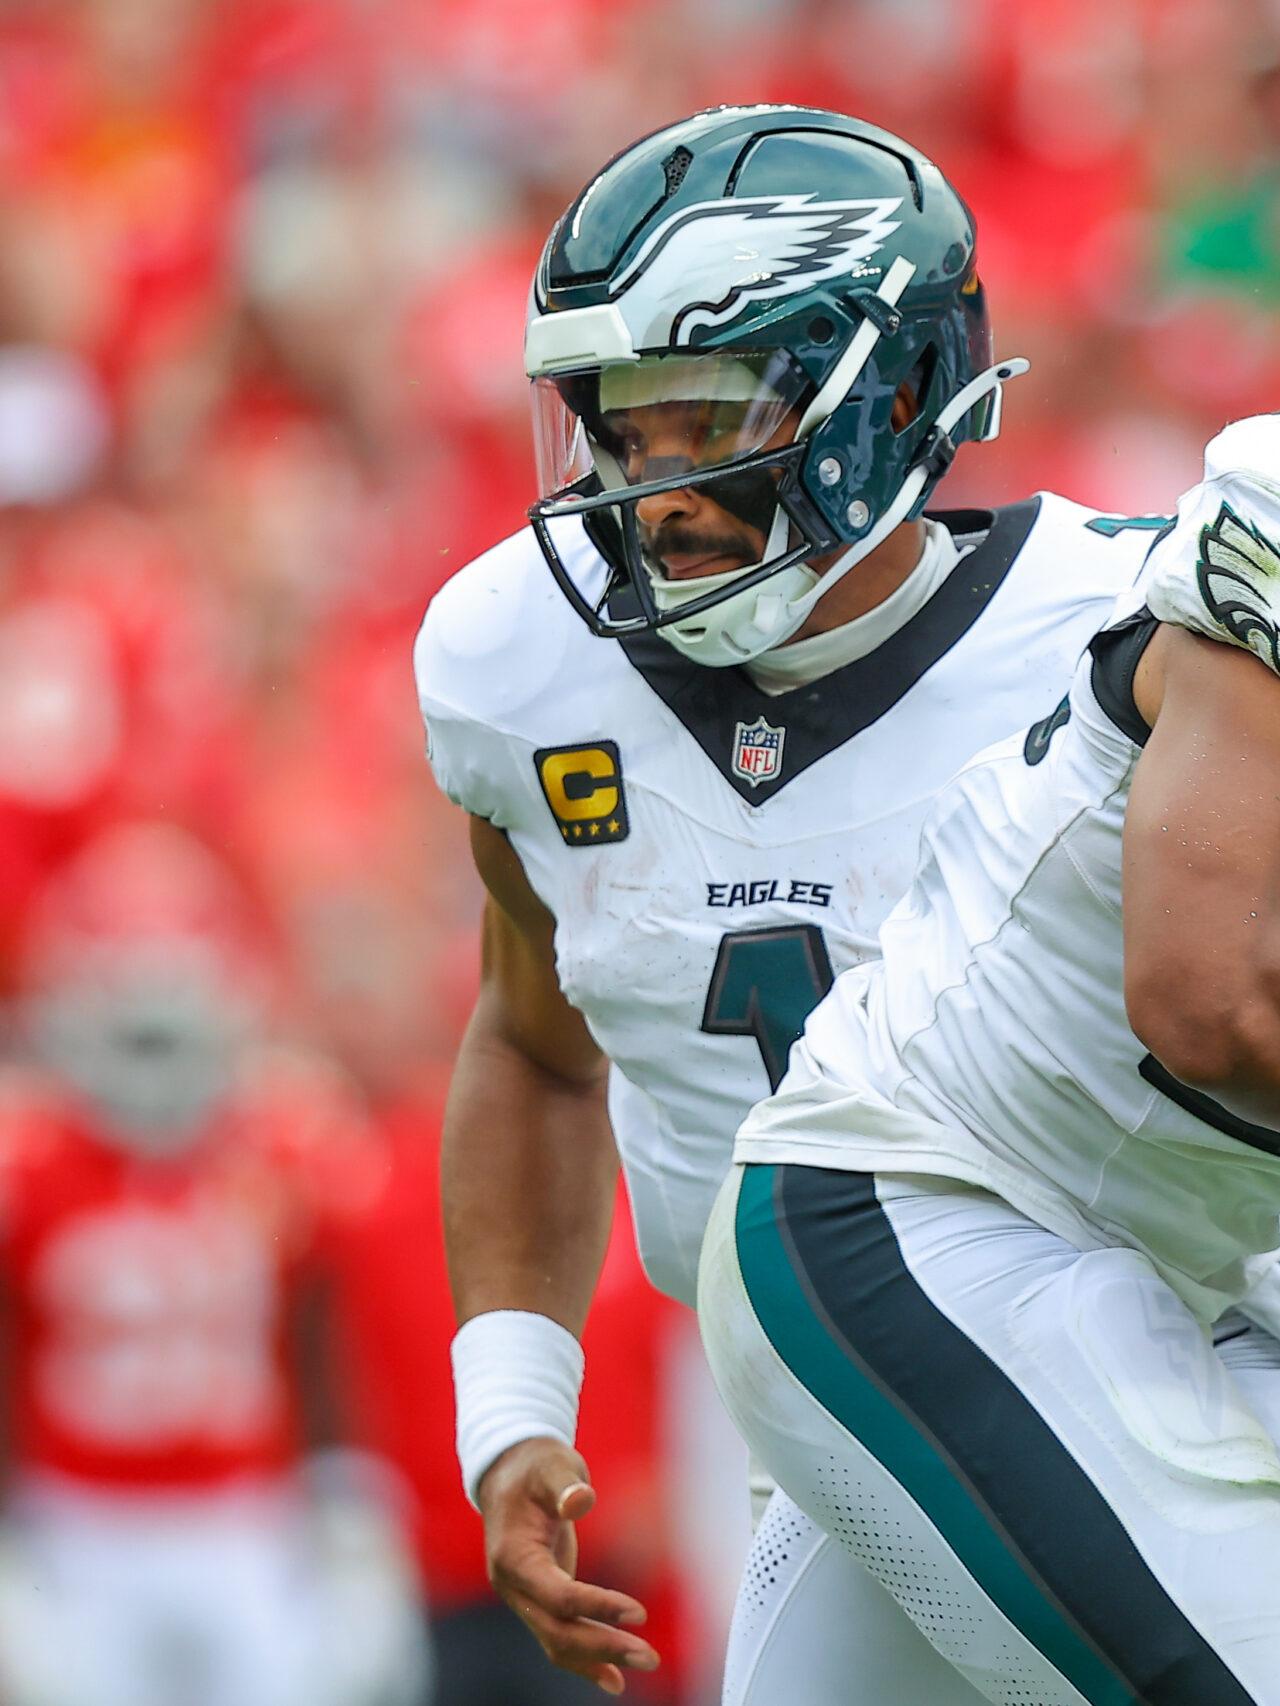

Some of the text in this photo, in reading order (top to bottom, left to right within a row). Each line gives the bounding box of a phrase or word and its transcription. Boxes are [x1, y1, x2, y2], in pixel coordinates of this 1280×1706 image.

[740, 748, 774, 773] NFL
[541, 748, 618, 821] C
[706, 879, 834, 908] EAGLES
